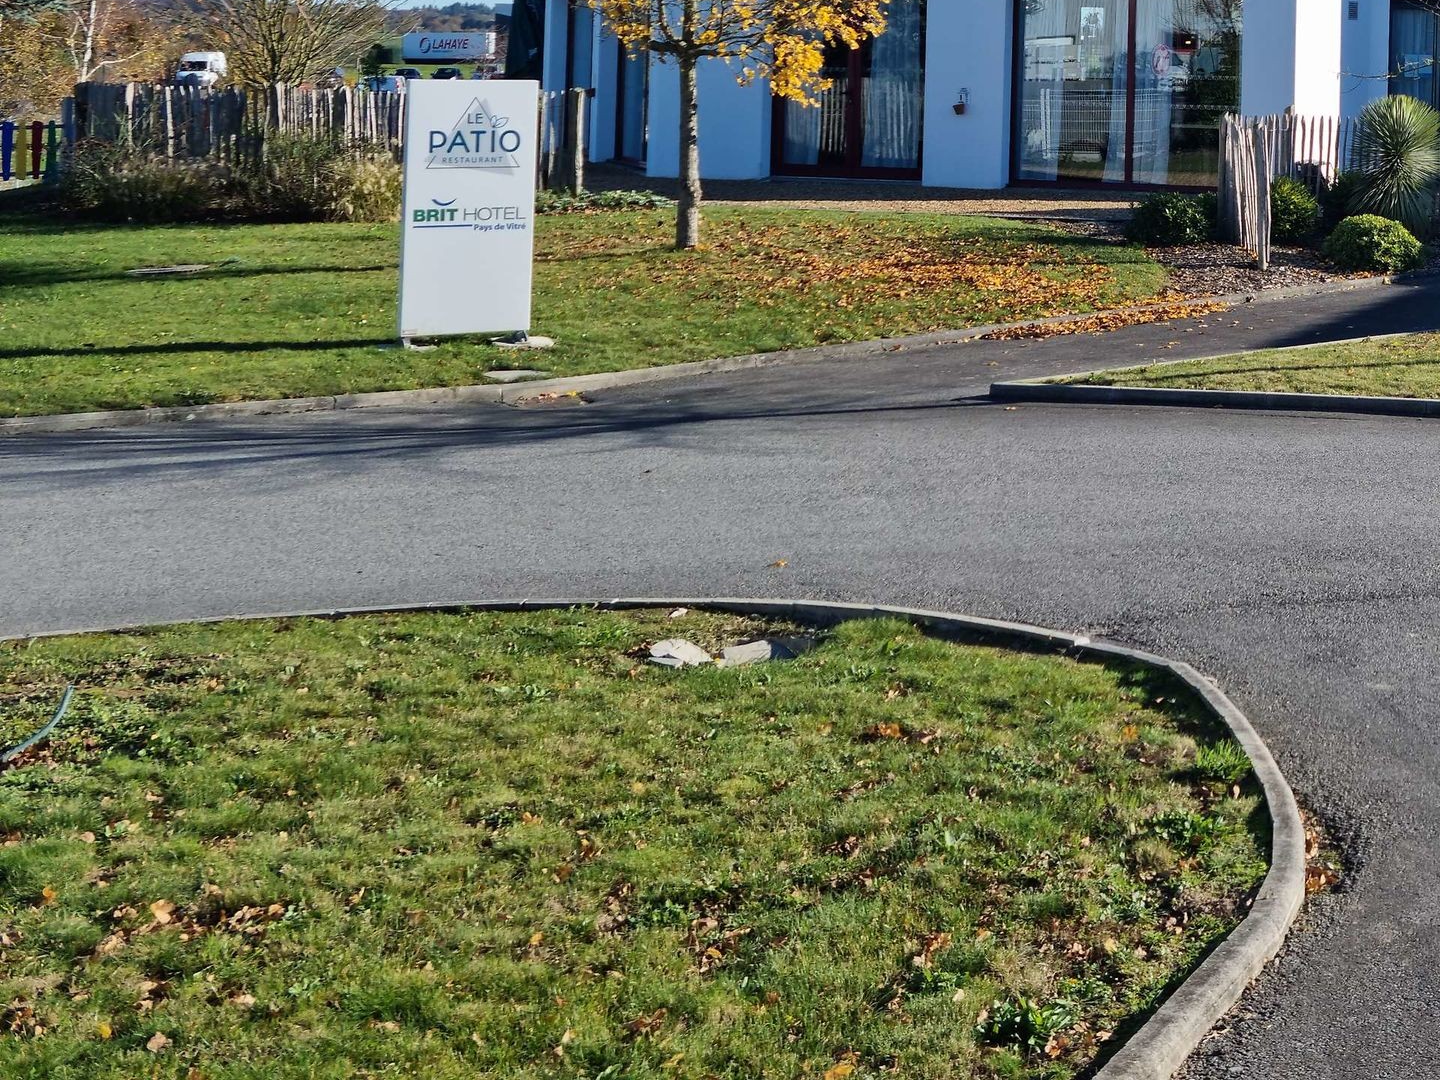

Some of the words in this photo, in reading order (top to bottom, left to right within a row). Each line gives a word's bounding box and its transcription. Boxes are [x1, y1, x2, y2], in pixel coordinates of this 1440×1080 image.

[432, 38, 469, 50] LAHAYE
[467, 112, 484, 124] LE
[428, 129, 521, 154] PATIO
[441, 156, 504, 164] RESTAURANT
[412, 207, 459, 222] BRIT
[463, 206, 527, 221] HOTEL
[473, 223, 493, 232] Pays
[494, 223, 505, 231] de
[506, 222, 527, 230] Vitré
